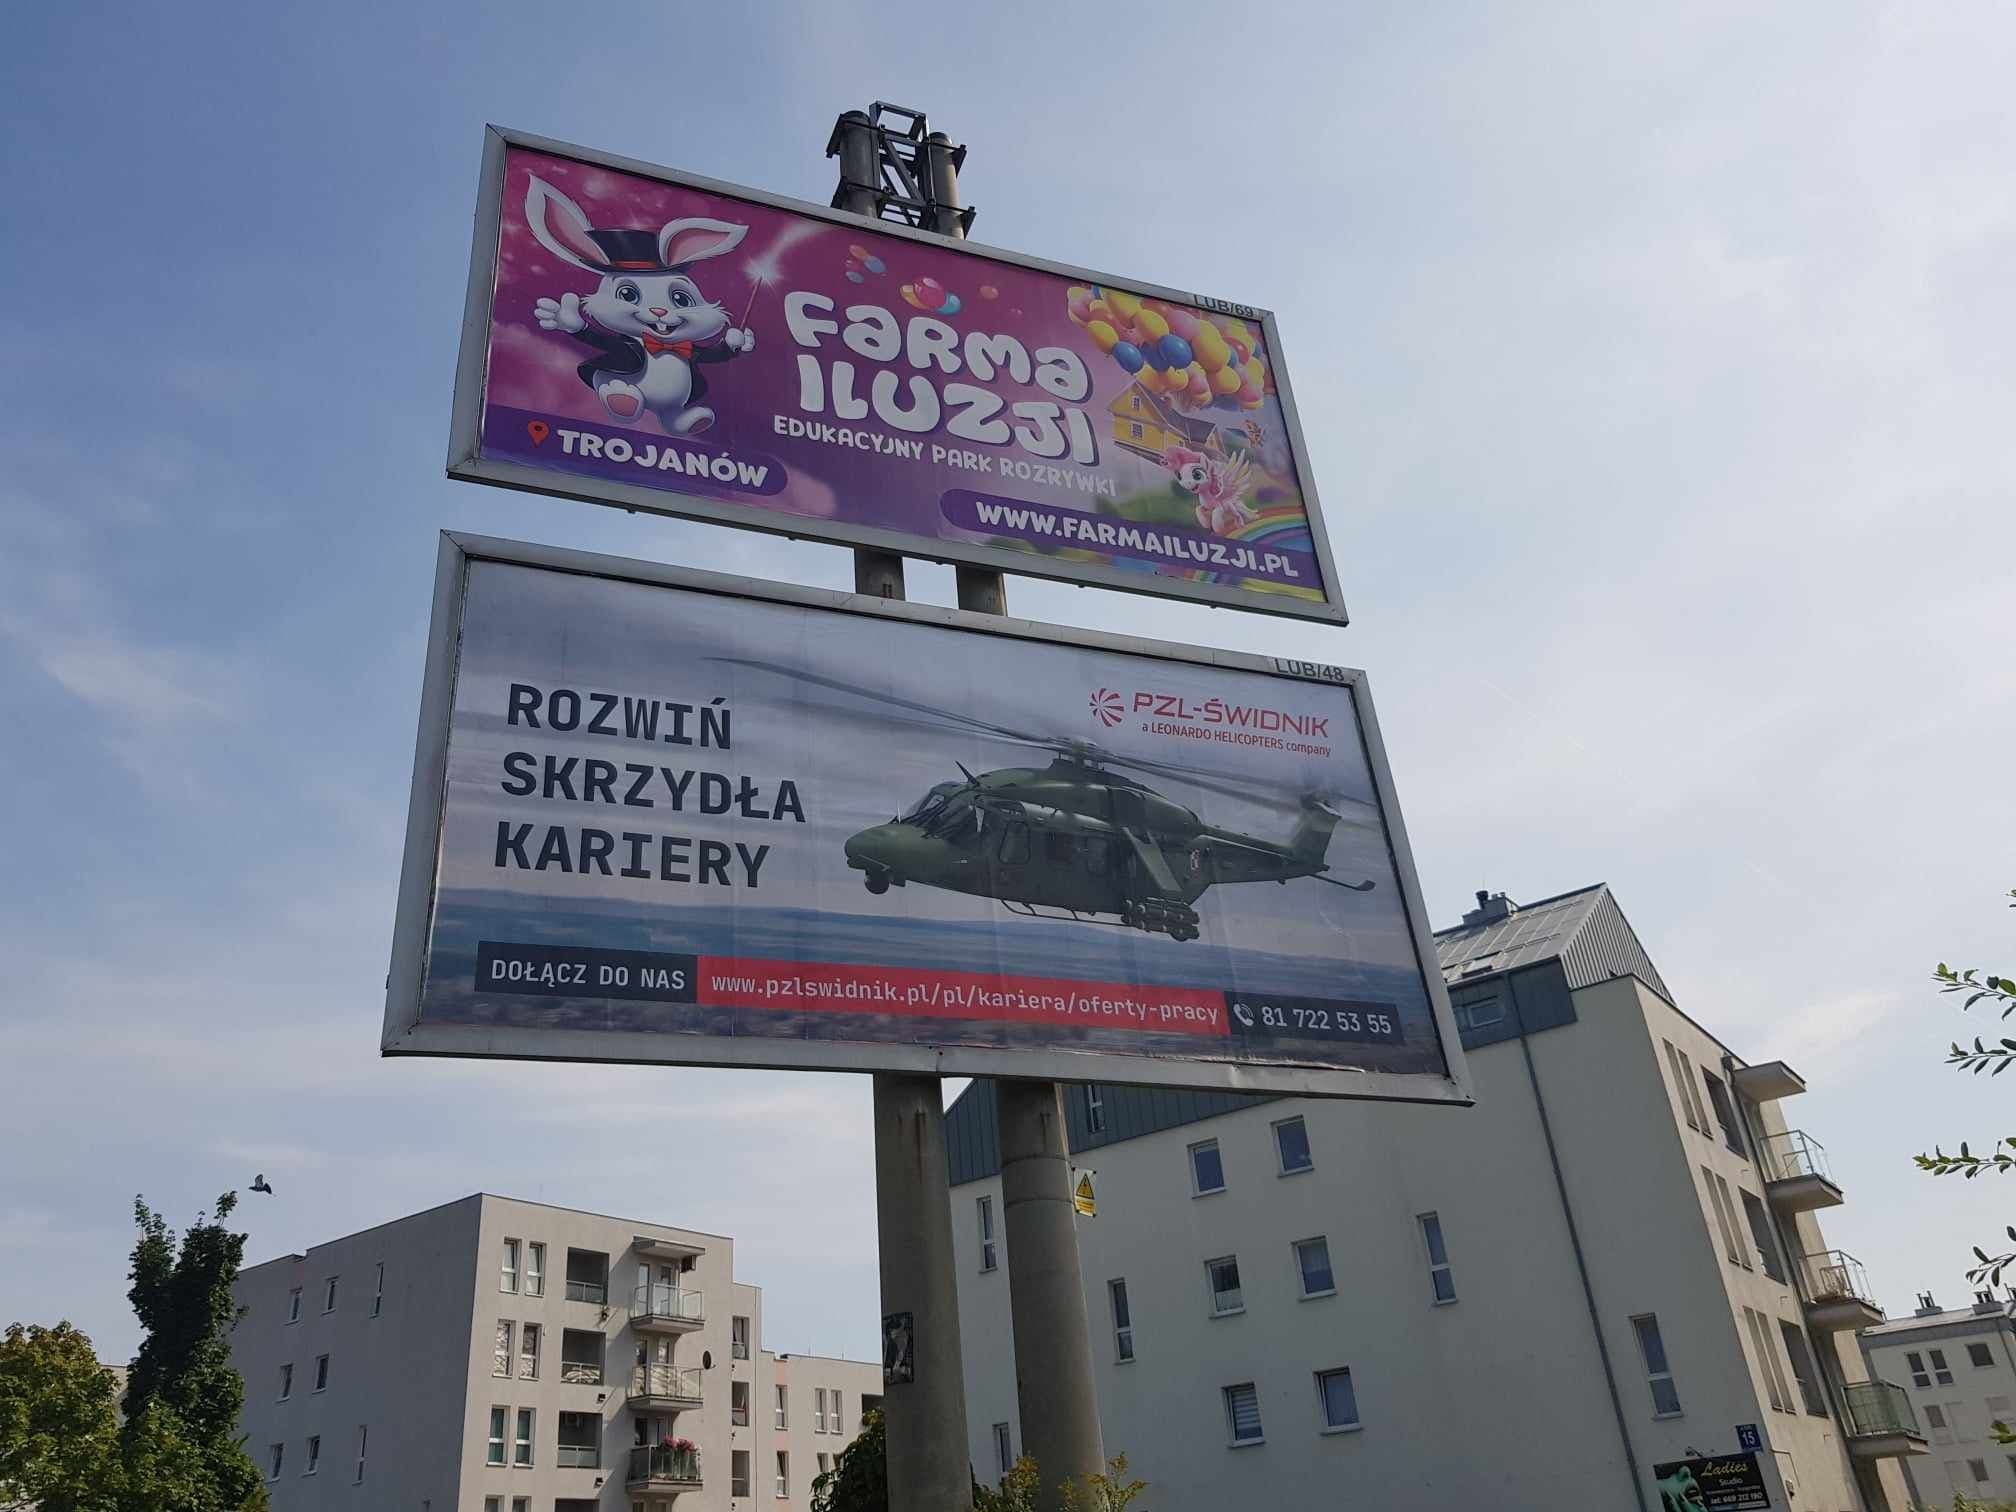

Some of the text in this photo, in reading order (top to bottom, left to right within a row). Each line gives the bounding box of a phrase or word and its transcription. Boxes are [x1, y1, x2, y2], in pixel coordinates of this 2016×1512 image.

[1193, 294, 1254, 317] LUB/69
[796, 354, 1096, 465] ILUZJI
[557, 429, 769, 488] TROJANÓW
[773, 415, 1117, 497] EDUKACYJNY PARK ROZRYWKI
[976, 501, 1299, 577] WWW.FARMAILUZJI.PL
[1274, 658, 1345, 682] LUB/48
[507, 683, 732, 750] ROZWIŃ
[1133, 692, 1329, 738] PZL-ŚWIDNIK
[1142, 722, 1332, 758] a LEONARDO HELICOPTERS company
[501, 751, 806, 823] SKRZYDŁA
[494, 820, 771, 888] KARIERY
[491, 959, 686, 990] DOŁĄCZ DO NAS
[711, 975, 1219, 1025] www.pzlswidnik.pl/pl/kariera/oferty-pracy
[1261, 1006, 1392, 1035] 81 722 53 55
[1742, 1431, 1756, 1446] 15
[1701, 1461, 1749, 1477] Ladies
